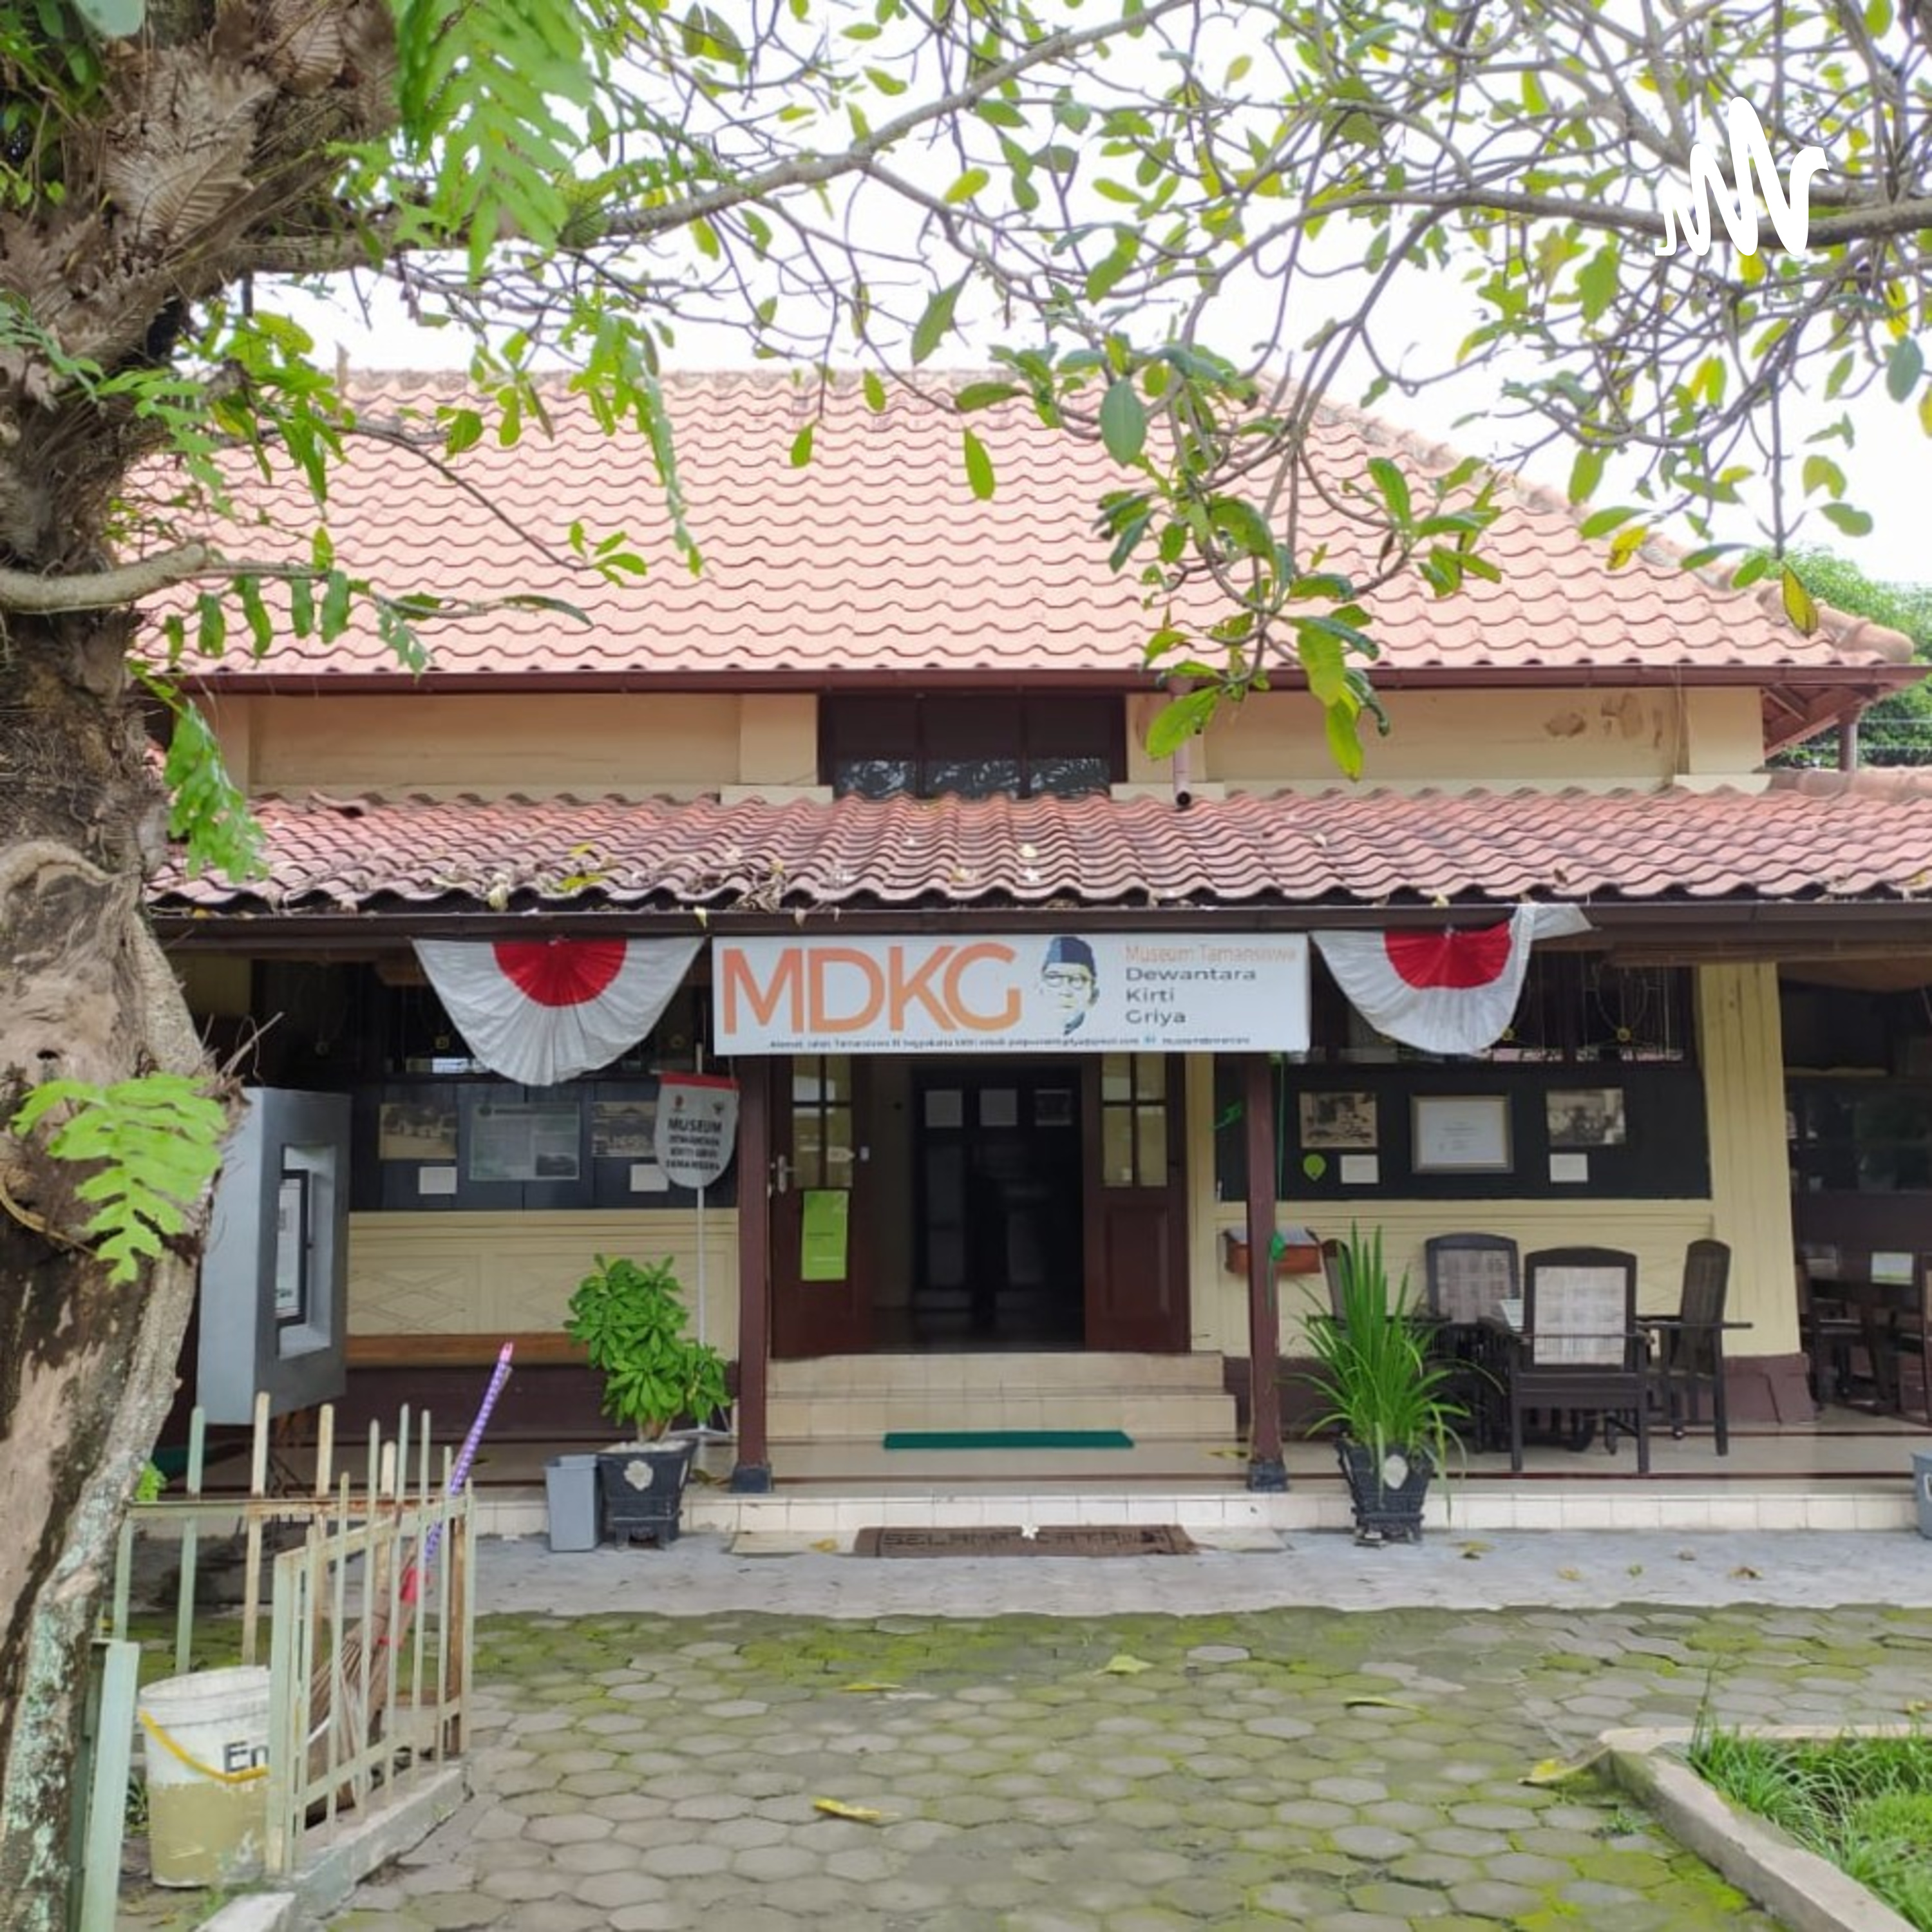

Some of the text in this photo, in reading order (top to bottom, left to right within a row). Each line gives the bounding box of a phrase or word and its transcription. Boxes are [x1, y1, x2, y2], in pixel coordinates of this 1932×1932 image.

[1125, 945, 1195, 962] Museum
[1125, 967, 1256, 981] Dewantara
[722, 942, 1021, 1034] MDKG
[1126, 987, 1175, 1003] Kirti
[1125, 1009, 1186, 1027] Griya
[668, 1117, 723, 1133] MUSEUM
